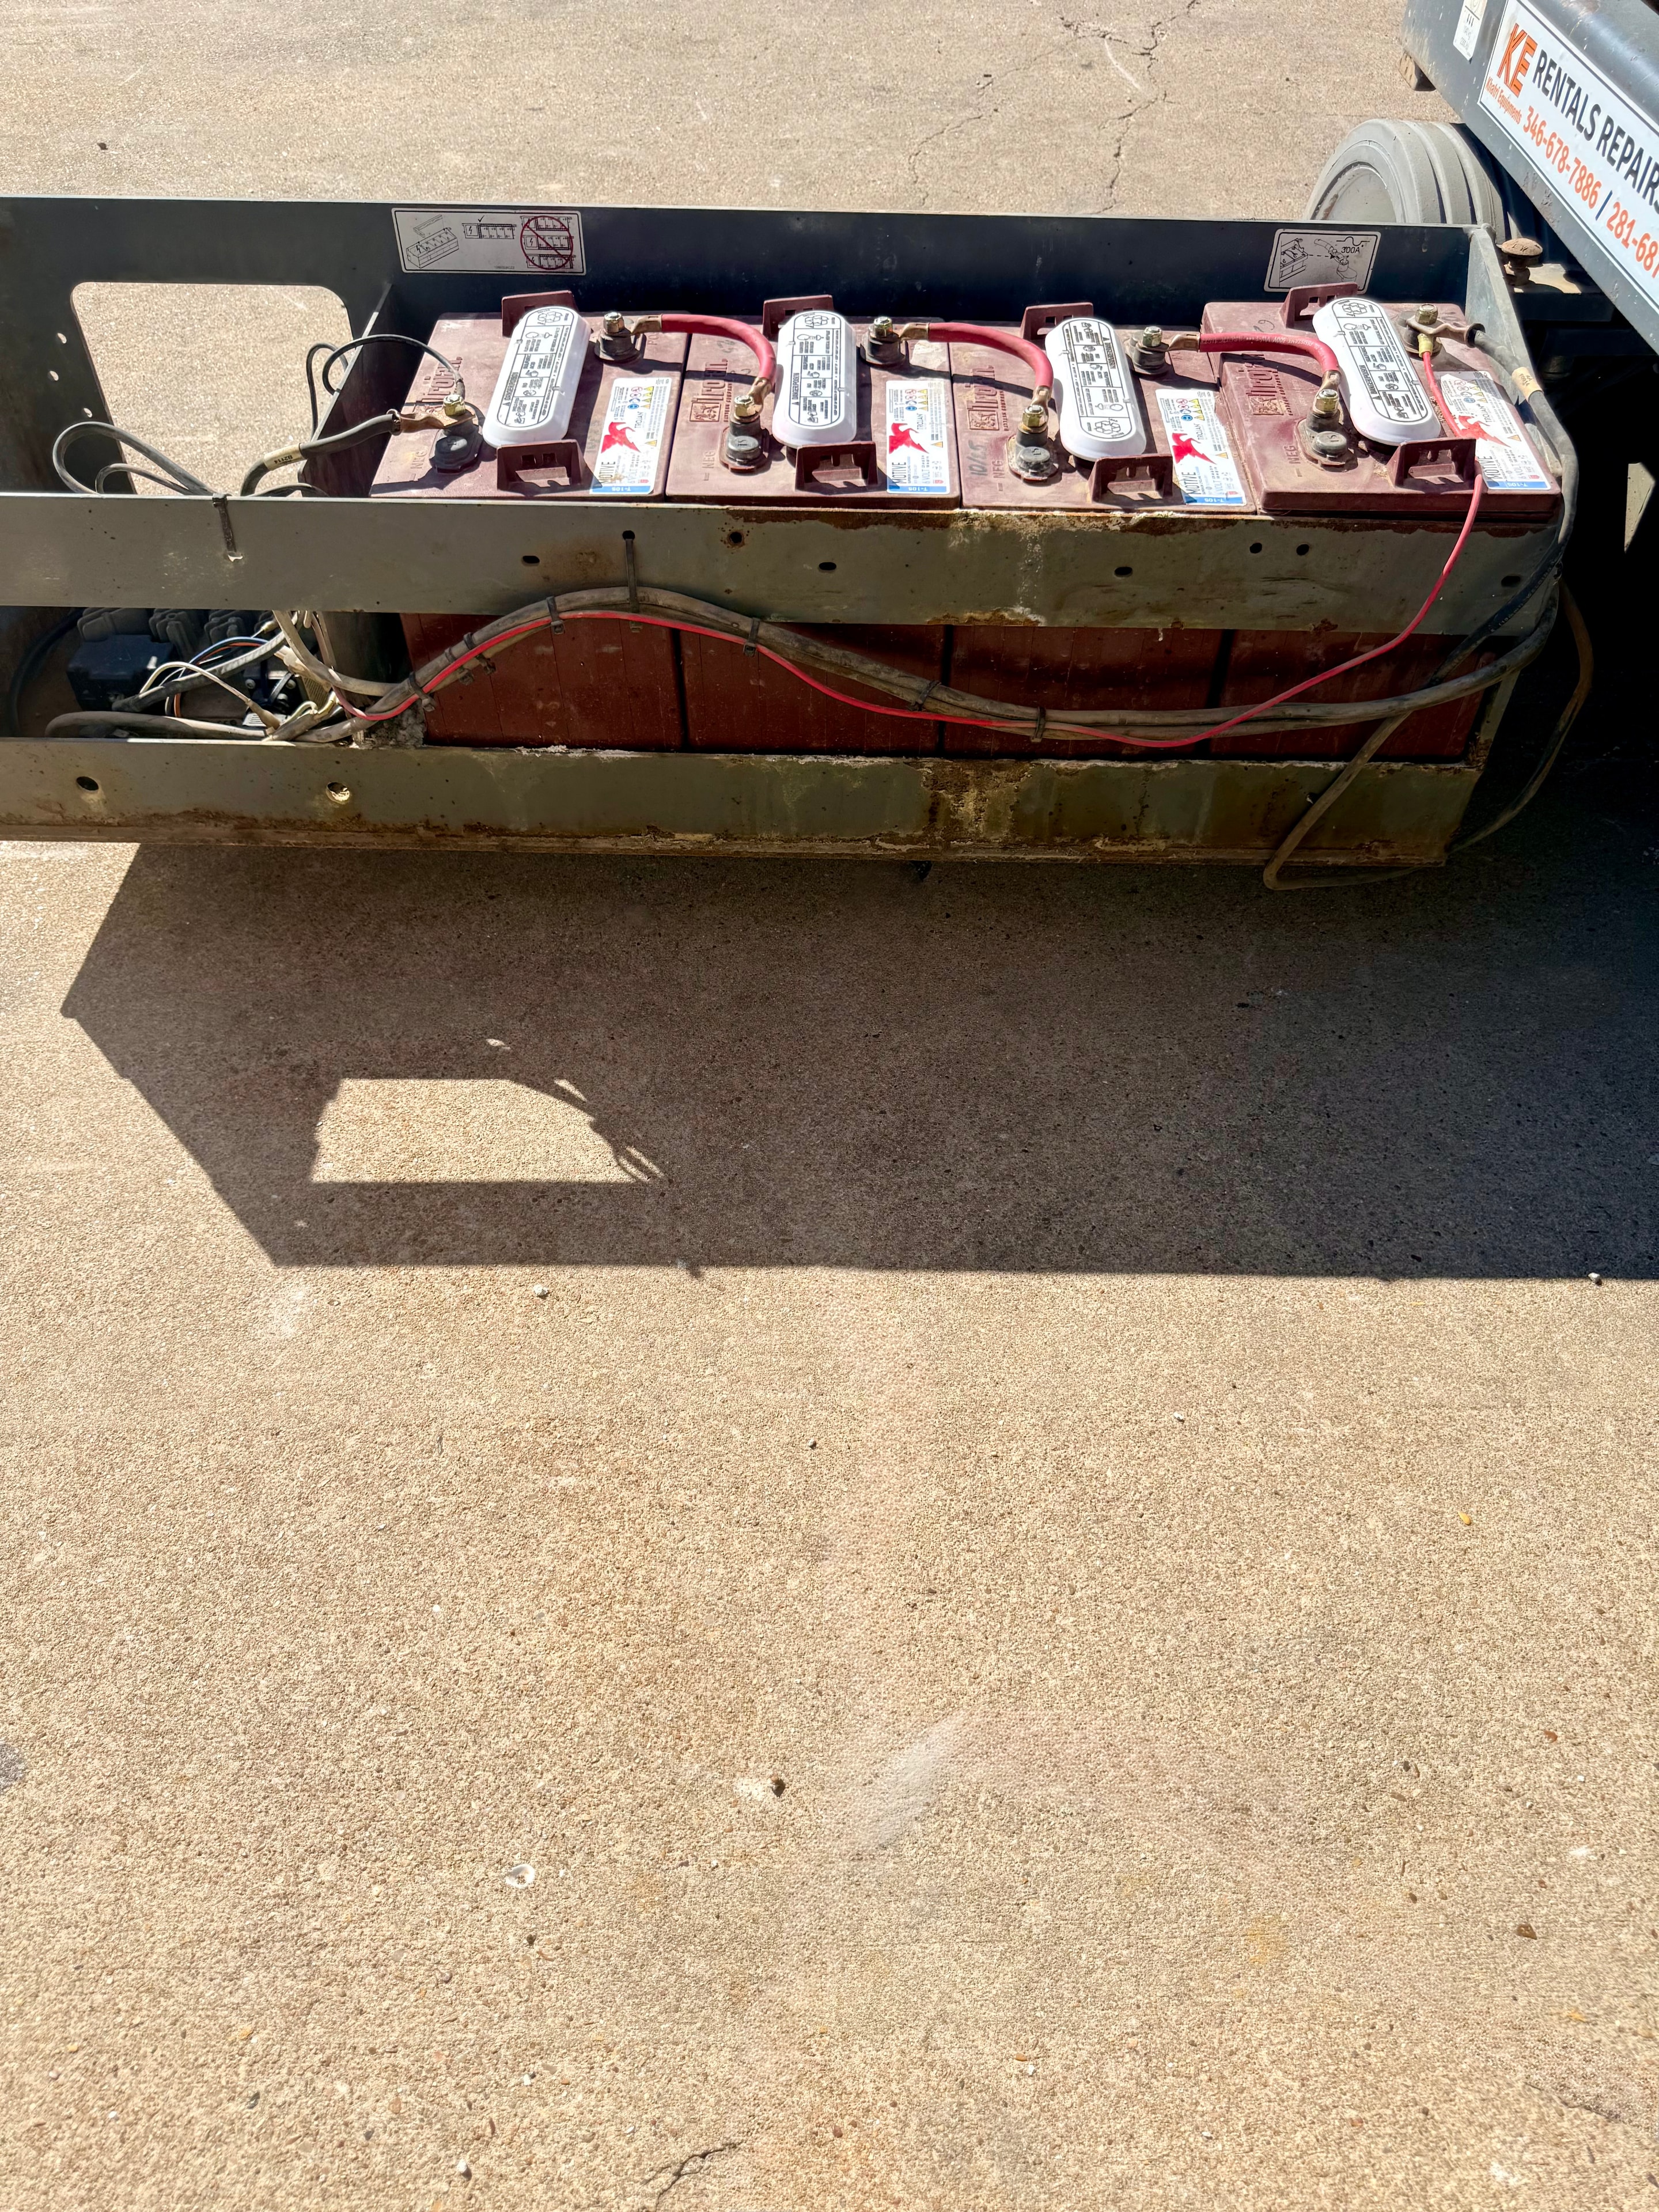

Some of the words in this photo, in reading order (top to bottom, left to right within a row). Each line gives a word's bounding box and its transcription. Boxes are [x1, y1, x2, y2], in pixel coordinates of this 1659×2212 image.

[1485, 77, 1499, 100] Khatri
[1497, 90, 1522, 124] Equipments
[1497, 23, 1537, 97] KE
[1532, 49, 1601, 141] RENTALS
[1596, 116, 1659, 215] REPAIR
[1523, 106, 1601, 209] 346-678-7886
[1479, 406, 1493, 423] TROJAN
[274, 454, 293, 464] B2114
[702, 450, 715, 469] NEG
[1283, 445, 1301, 464] NEG
[599, 461, 616, 483] MOTIVE
[892, 462, 907, 483] MOTIVE
[991, 460, 1005, 479] NEG
[1478, 456, 1503, 479] MOTIVE
[1181, 472, 1202, 495] MOTIVE
